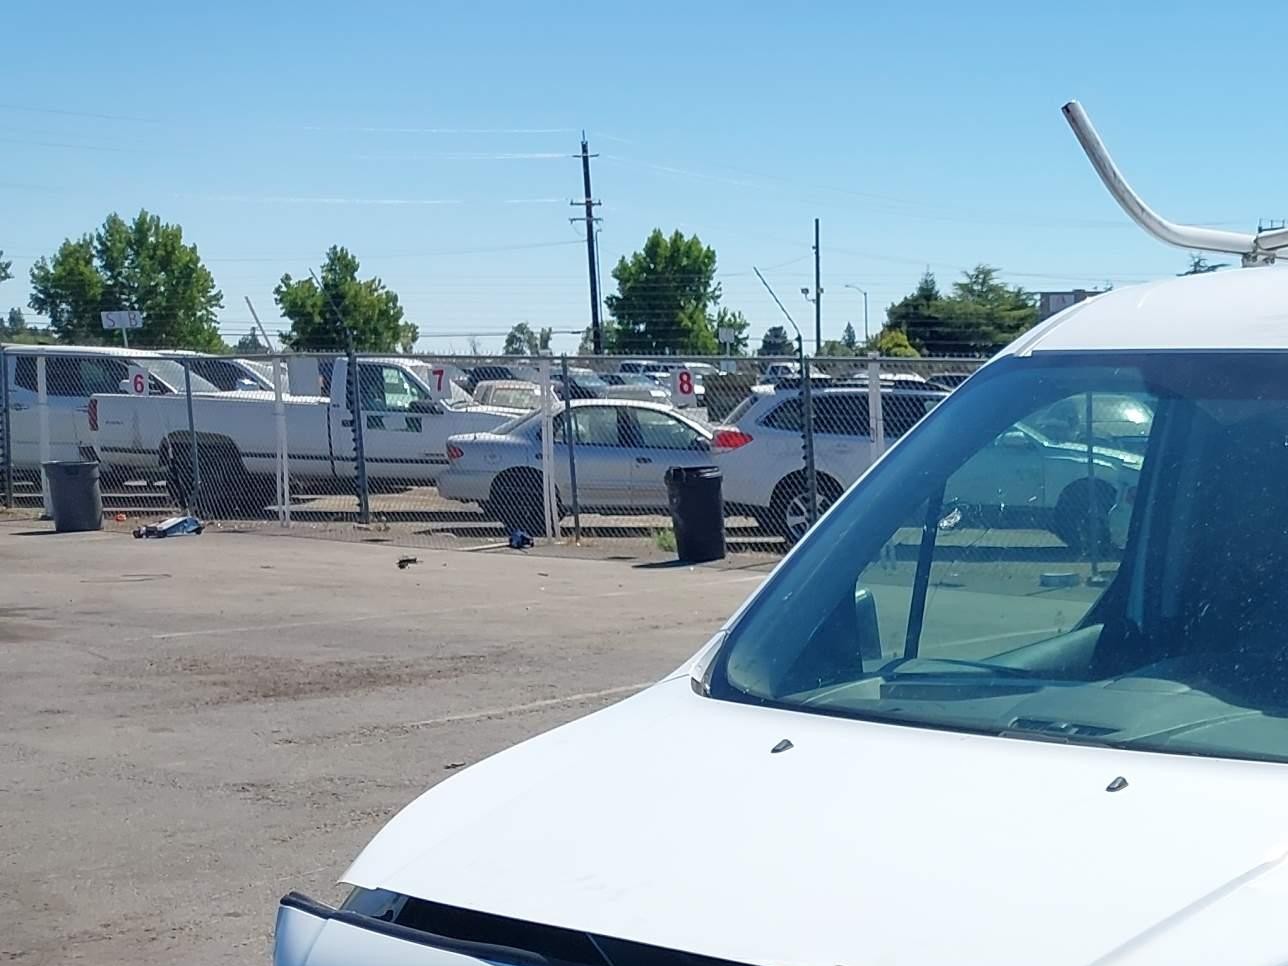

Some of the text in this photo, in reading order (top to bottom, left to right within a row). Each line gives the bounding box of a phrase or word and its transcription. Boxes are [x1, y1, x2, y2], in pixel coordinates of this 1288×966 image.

[133, 374, 145, 394] 6
[432, 368, 444, 393] 7
[679, 371, 693, 394] 8
